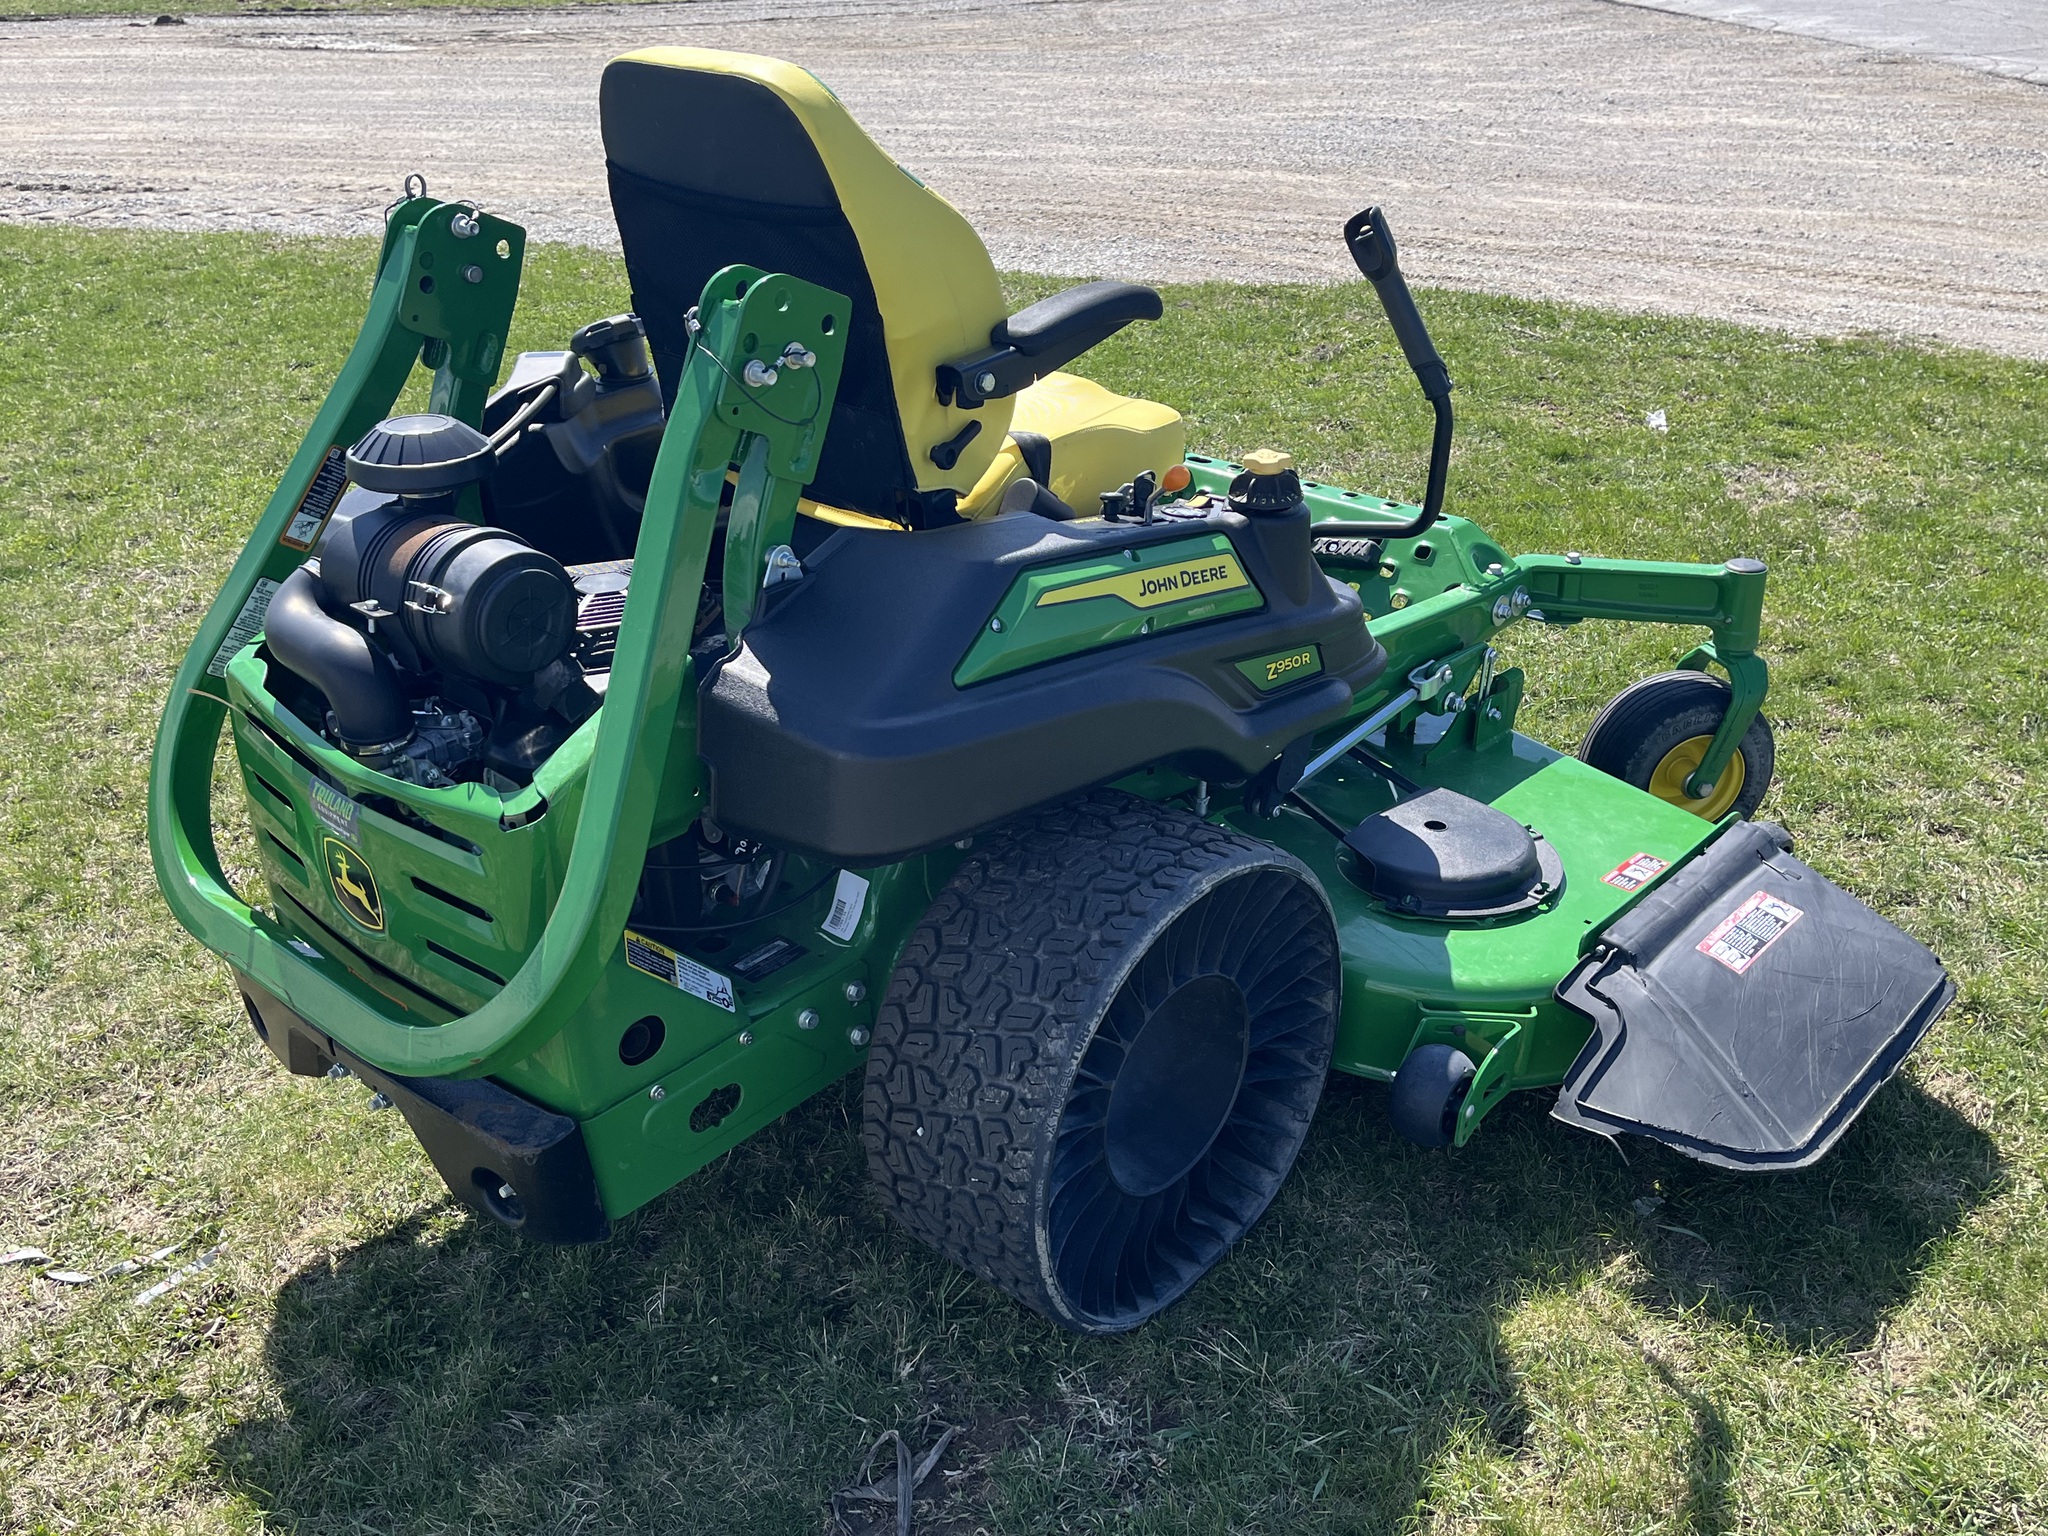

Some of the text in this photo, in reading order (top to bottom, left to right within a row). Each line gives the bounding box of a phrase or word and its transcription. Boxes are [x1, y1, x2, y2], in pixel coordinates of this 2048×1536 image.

[1139, 565, 1228, 597] JOHN DEERE
[1266, 652, 1311, 681] Z950R
[312, 781, 354, 821] TRULAND
[641, 938, 665, 954] CAUTION
[1051, 1068, 1075, 1119] TWEEL
[1070, 1022, 1091, 1061] TURF
